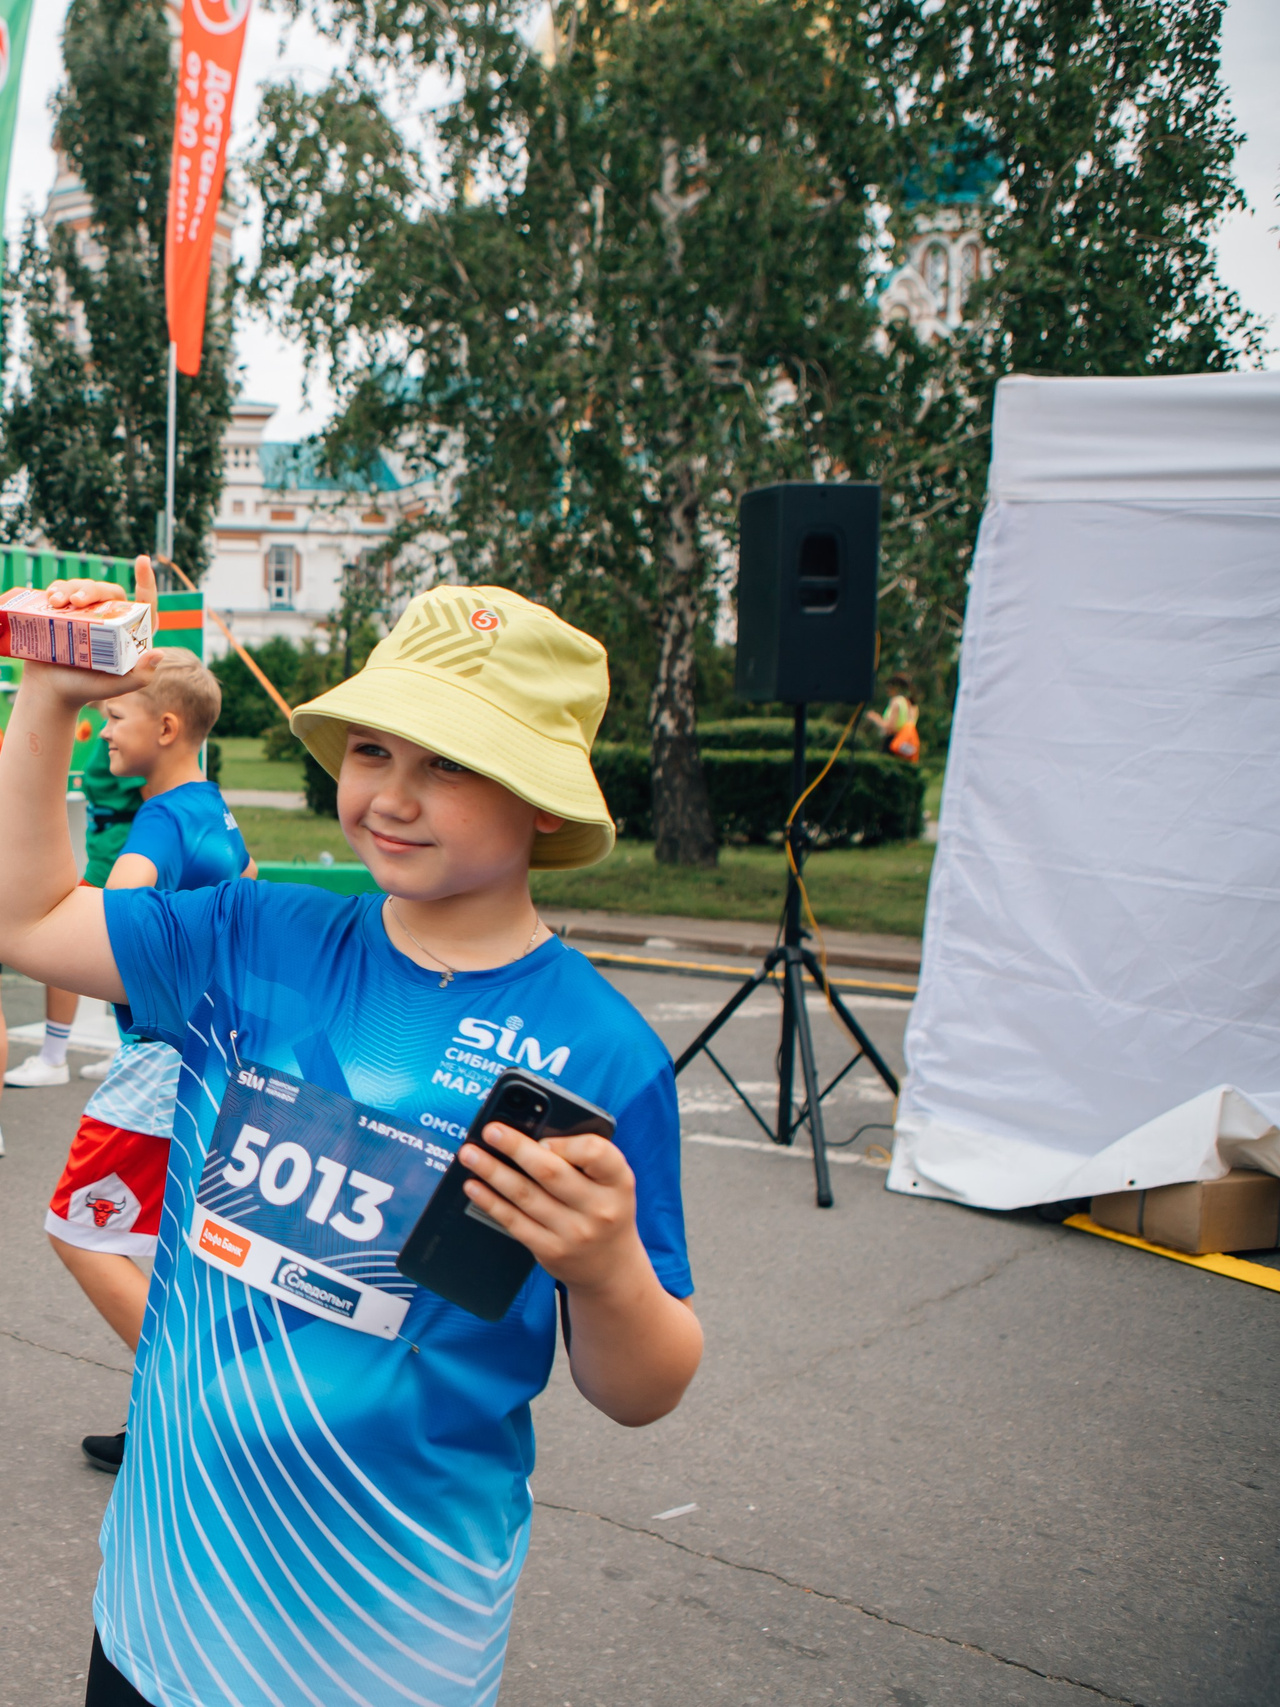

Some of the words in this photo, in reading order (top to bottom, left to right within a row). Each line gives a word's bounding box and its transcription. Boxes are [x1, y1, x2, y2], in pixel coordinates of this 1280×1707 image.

[179, 101, 200, 148] 30
[445, 1047, 507, 1076] СИБИР
[358, 1115, 368, 1127] 3
[367, 1120, 424, 1150] АВГУСТА
[424, 1142, 455, 1163] 2024
[222, 1124, 396, 1243] 5013
[424, 1157, 434, 1167] 3
[286, 1272, 354, 1312] Следопыт
